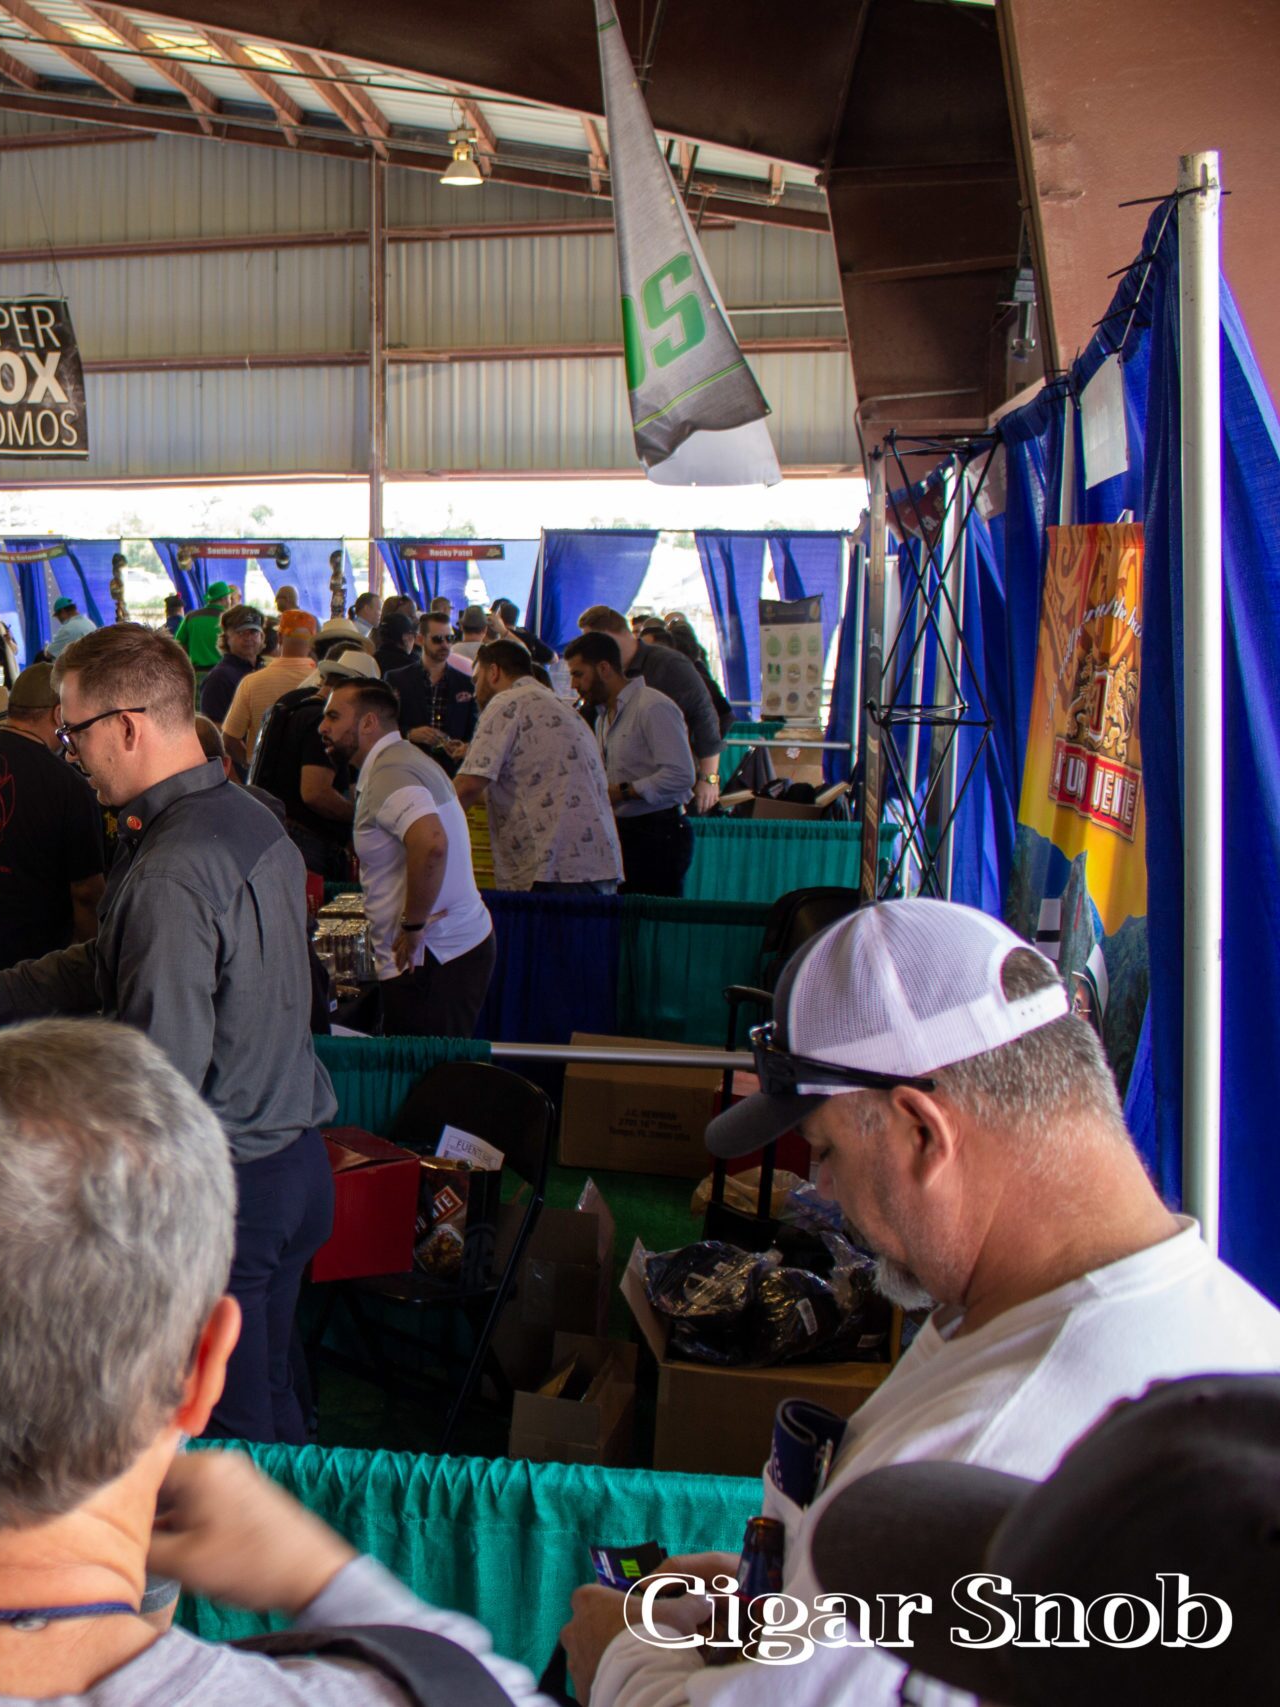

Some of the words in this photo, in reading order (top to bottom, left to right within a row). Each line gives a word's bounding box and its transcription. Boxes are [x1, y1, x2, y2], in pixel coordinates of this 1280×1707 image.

[207, 547, 240, 555] Southern
[241, 547, 260, 555] Draw
[429, 549, 452, 558] Rocky
[453, 548, 473, 557] Patel
